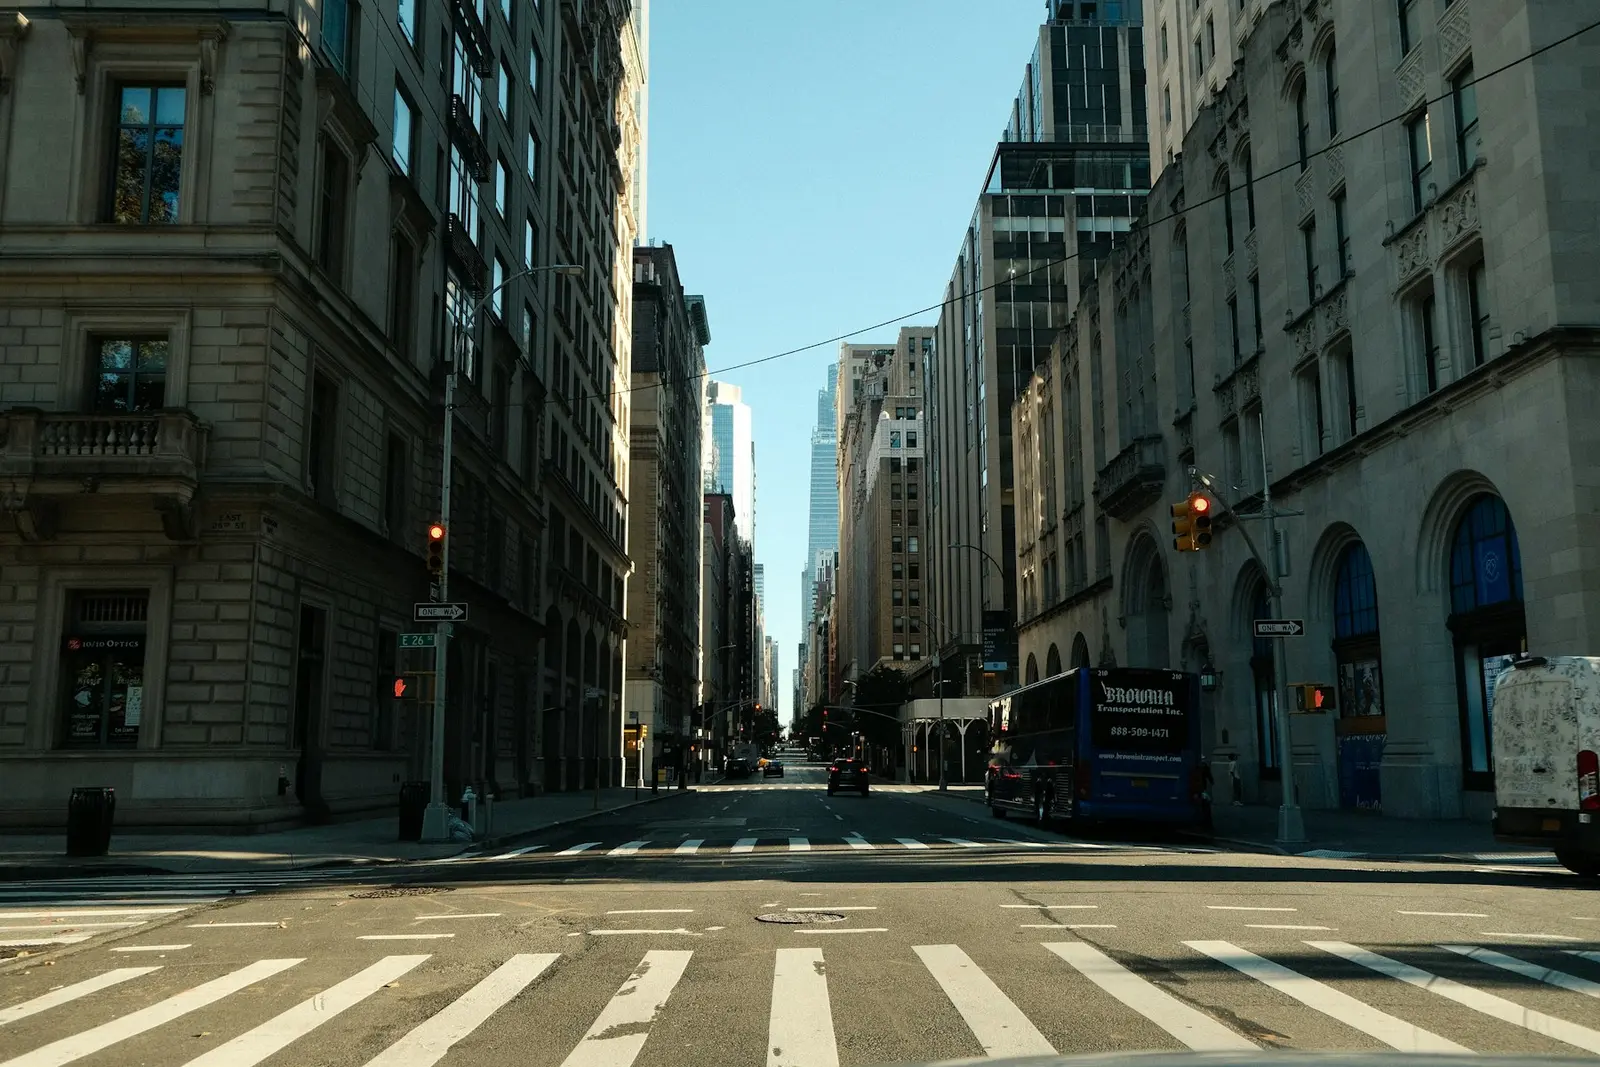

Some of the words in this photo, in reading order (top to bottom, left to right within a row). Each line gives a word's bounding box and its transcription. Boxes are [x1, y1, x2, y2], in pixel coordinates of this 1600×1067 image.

[422, 608, 437, 616] ONE
[443, 608, 460, 616] WAY
[1261, 624, 1276, 632] ONE
[1282, 624, 1296, 632] WAY
[82, 640, 105, 648] 10/10
[106, 639, 139, 648] OPTICS
[402, 635, 408, 645] E
[412, 635, 424, 645] 26
[1097, 669, 1109, 677] 210
[1096, 703, 1164, 715] Transportation
[1165, 706, 1184, 716] Inc.
[1110, 726, 1169, 738] 888-509-1471
